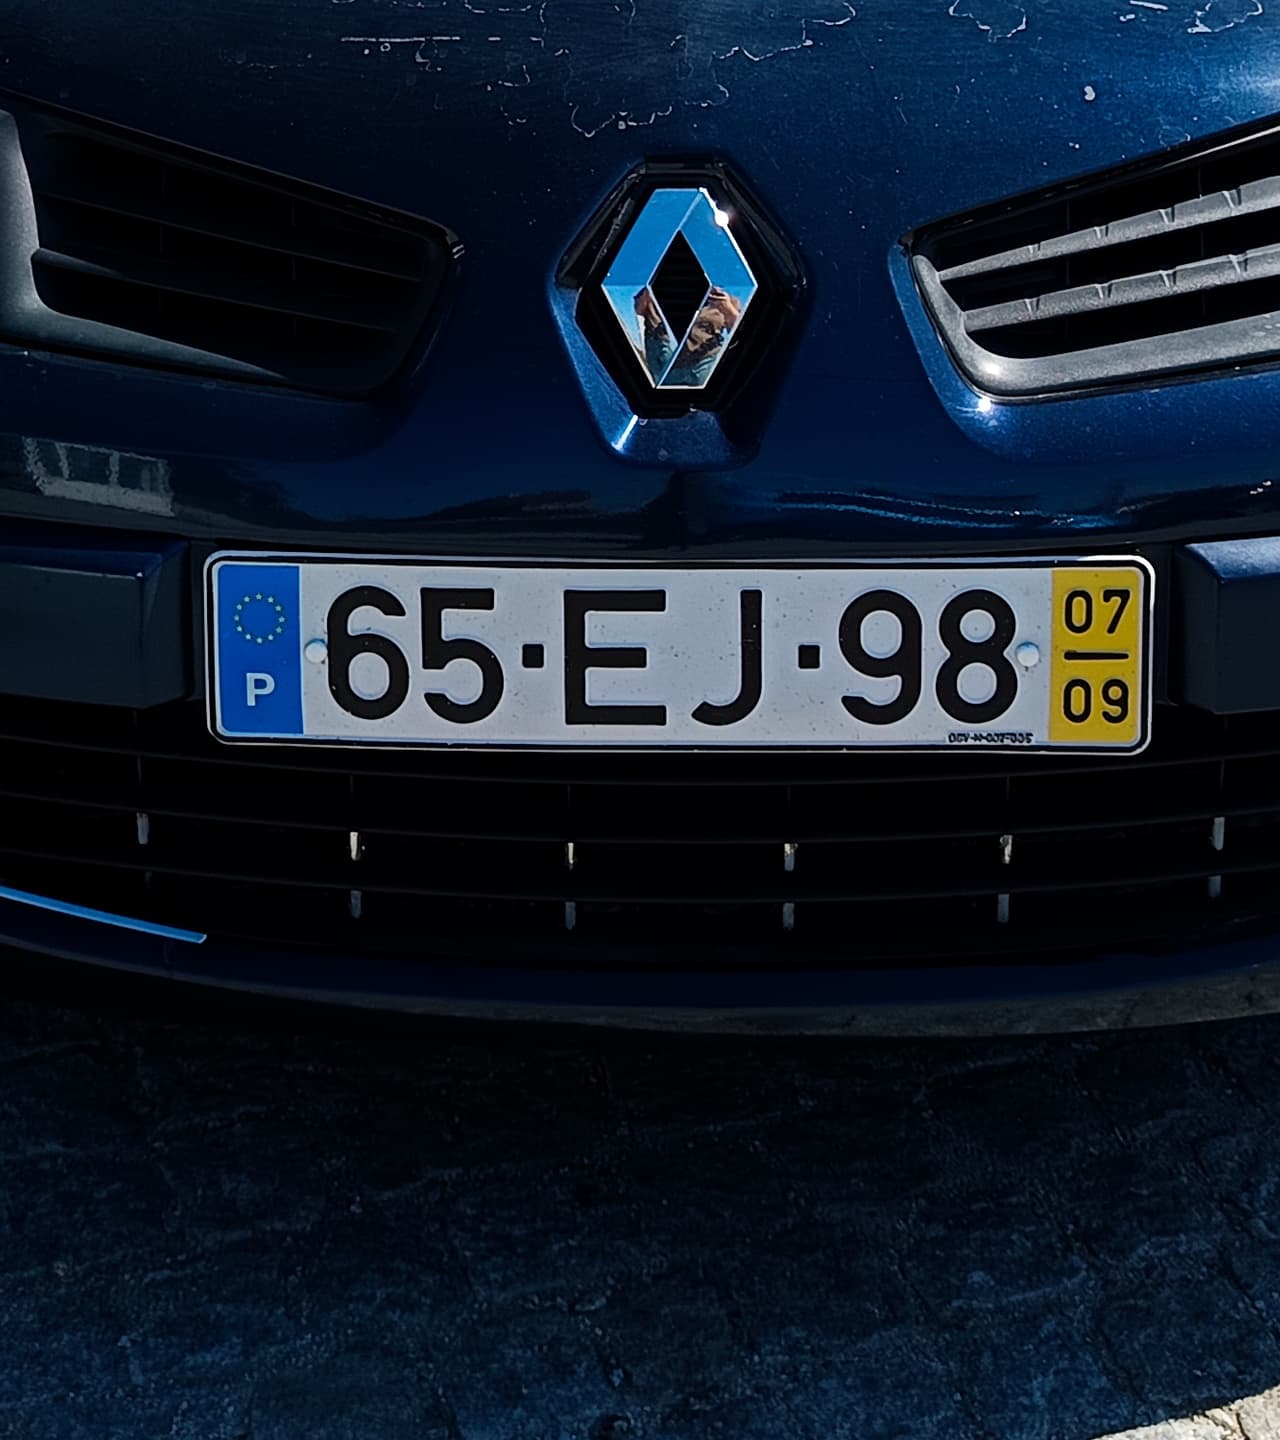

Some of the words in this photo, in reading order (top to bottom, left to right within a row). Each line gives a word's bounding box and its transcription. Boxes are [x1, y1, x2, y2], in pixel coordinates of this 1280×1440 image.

[1064, 589, 1131, 634] 07
[325, 584, 1018, 726] 65·EJ·98
[246, 672, 276, 707] P
[1063, 678, 1130, 724] 09
